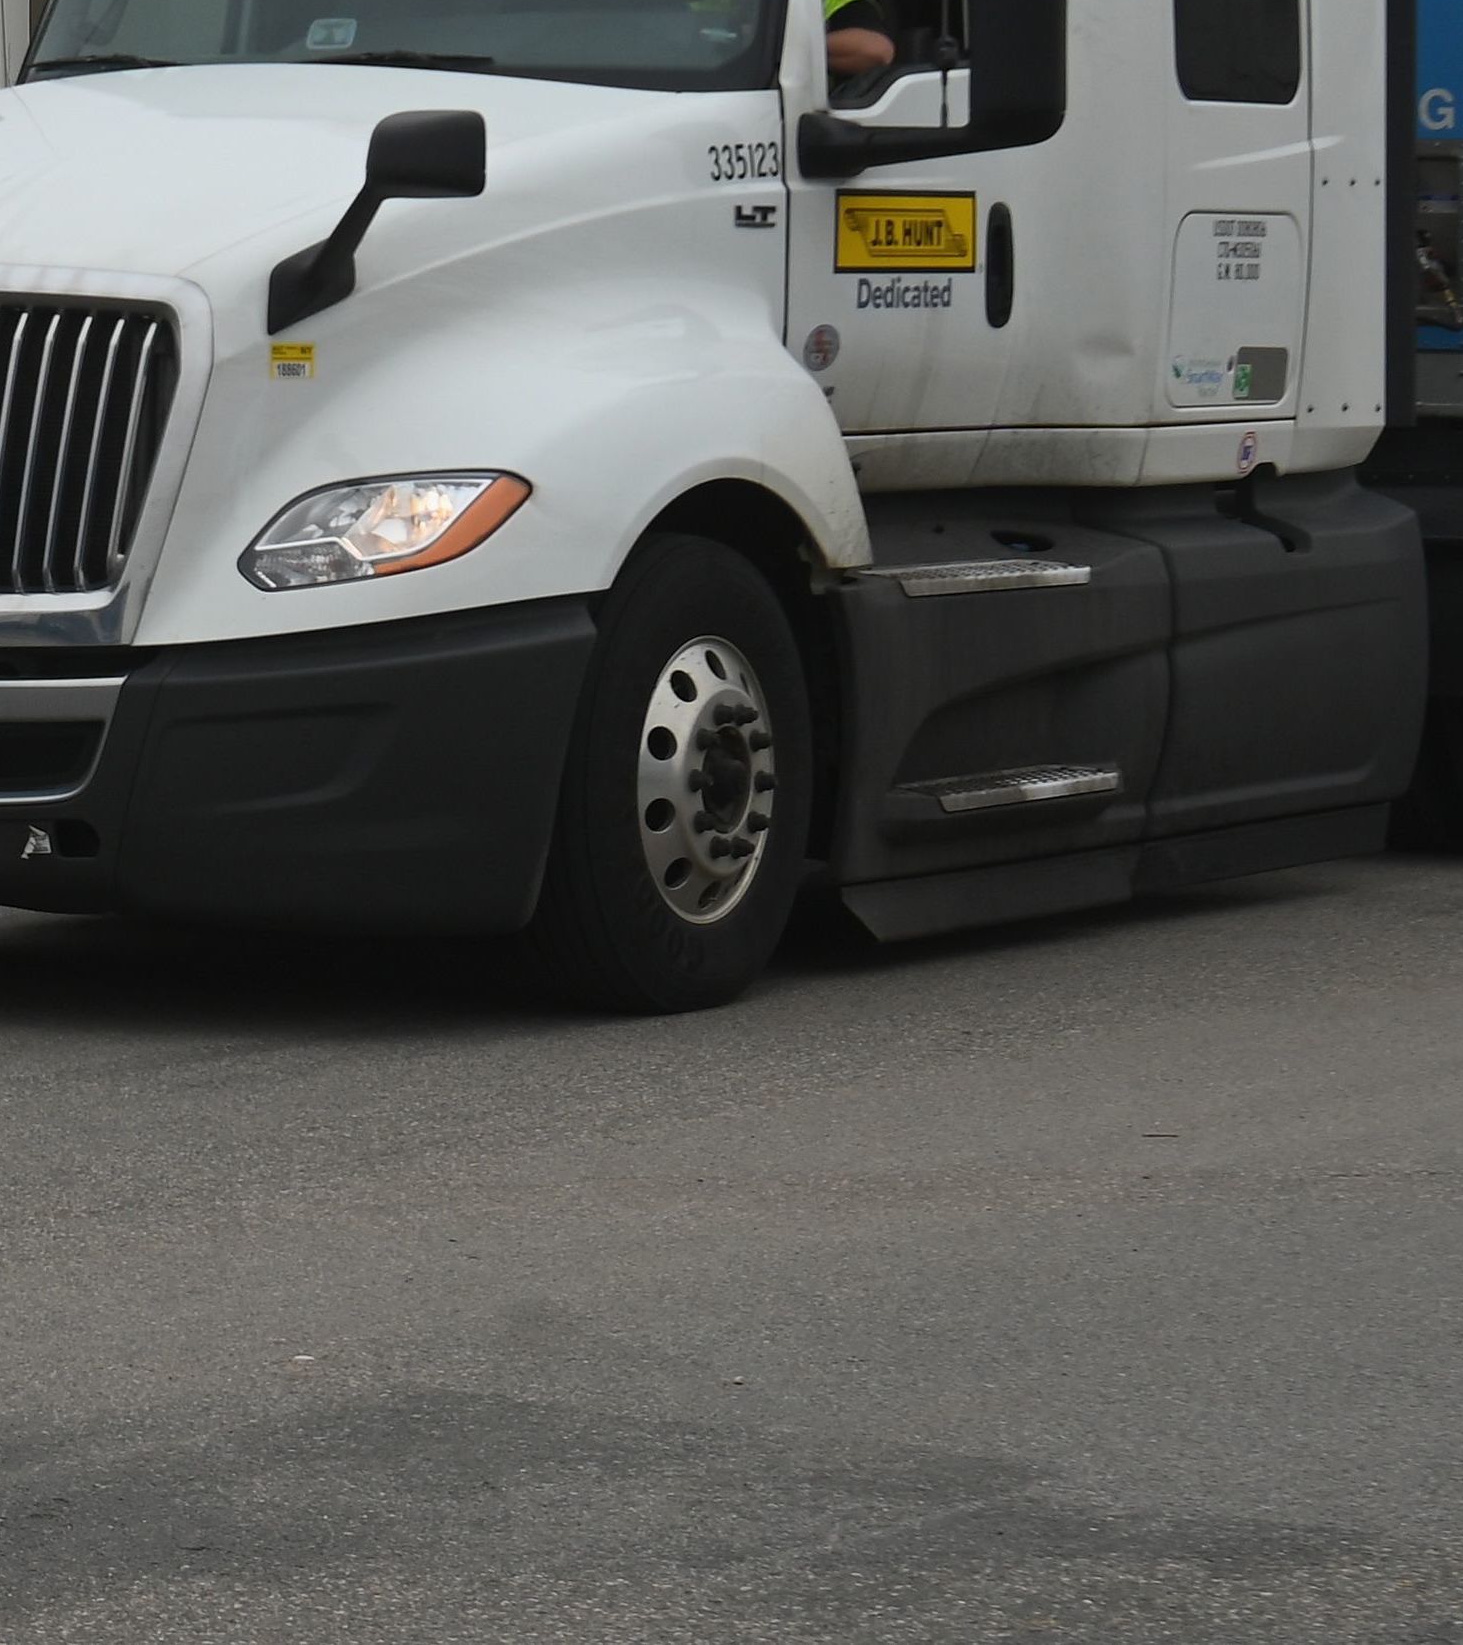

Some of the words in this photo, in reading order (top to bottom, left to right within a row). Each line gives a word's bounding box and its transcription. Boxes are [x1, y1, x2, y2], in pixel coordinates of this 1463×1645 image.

[708, 141, 779, 182] 335123
[735, 205, 777, 229] LT
[902, 219, 943, 247] HUNT
[856, 277, 952, 310] Dedicated
